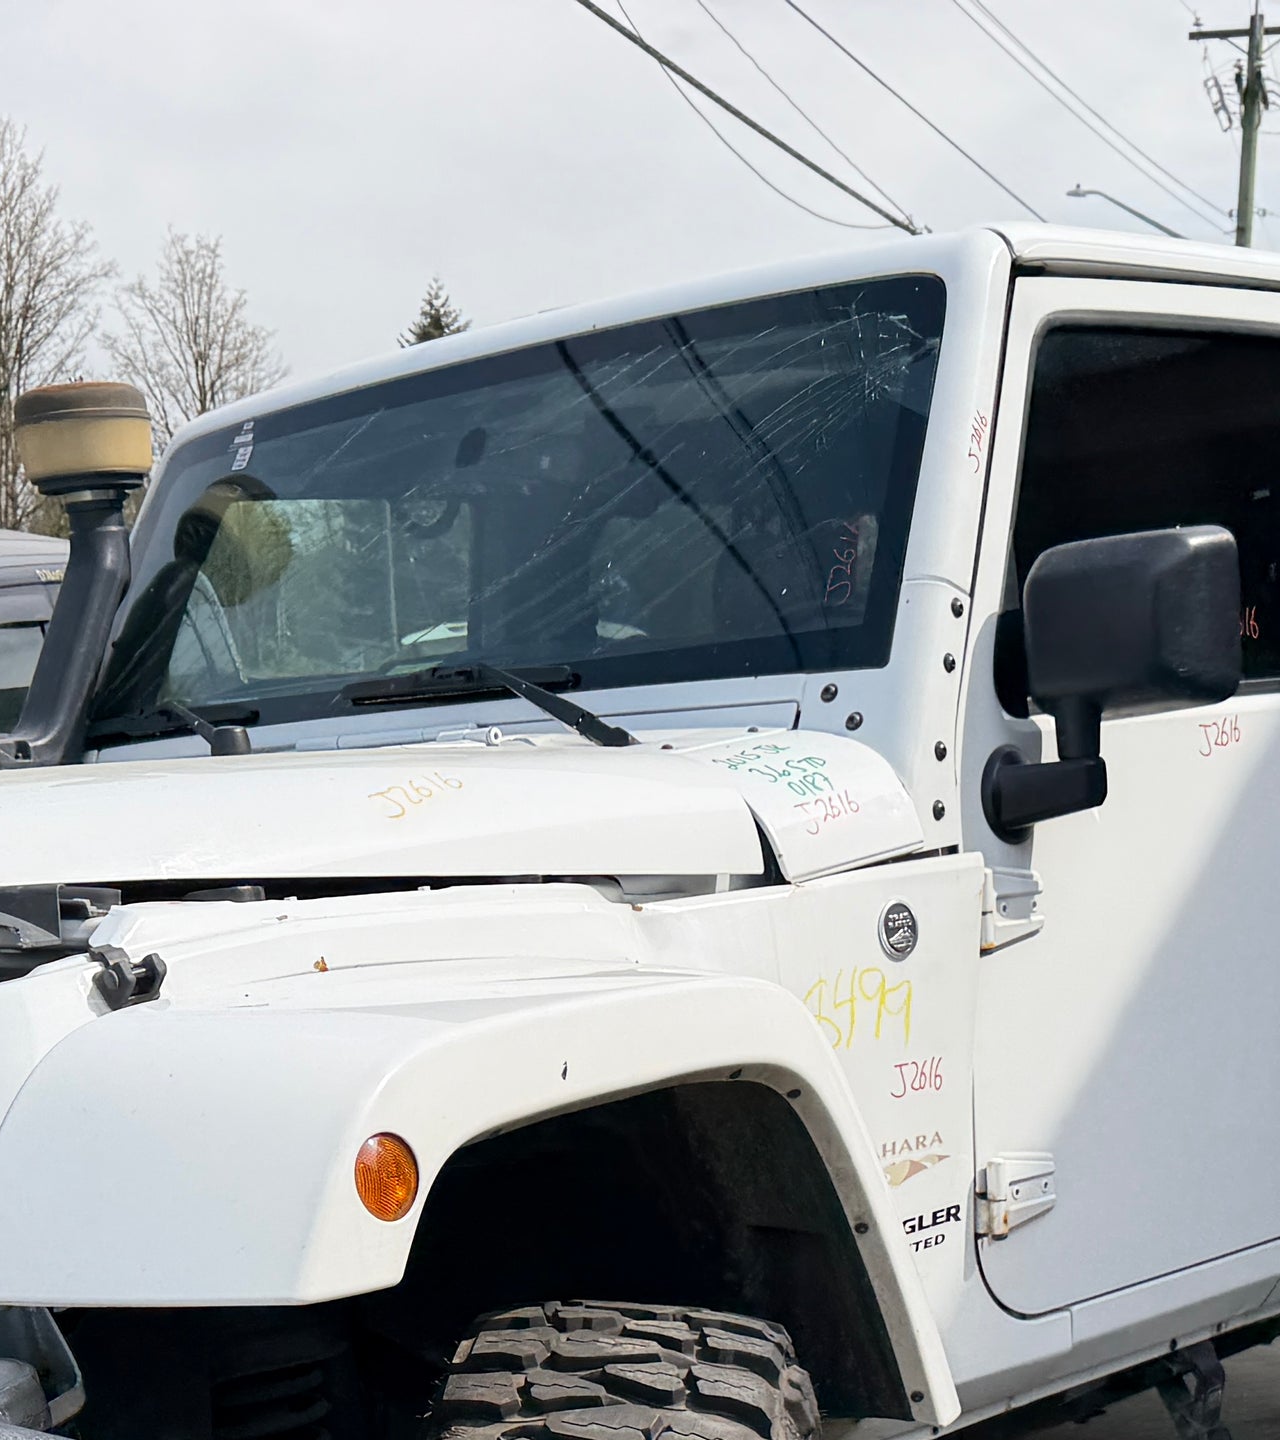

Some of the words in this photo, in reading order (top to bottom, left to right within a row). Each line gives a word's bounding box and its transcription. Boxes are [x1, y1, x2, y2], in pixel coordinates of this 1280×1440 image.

[1198, 714, 1241, 757] J2616
[367, 771, 463, 819] J2616
[793, 789, 860, 835] J2616
[890, 1055, 943, 1098] J2616
[878, 1131, 944, 1159] HARA
[909, 1233, 946, 1253] TED
